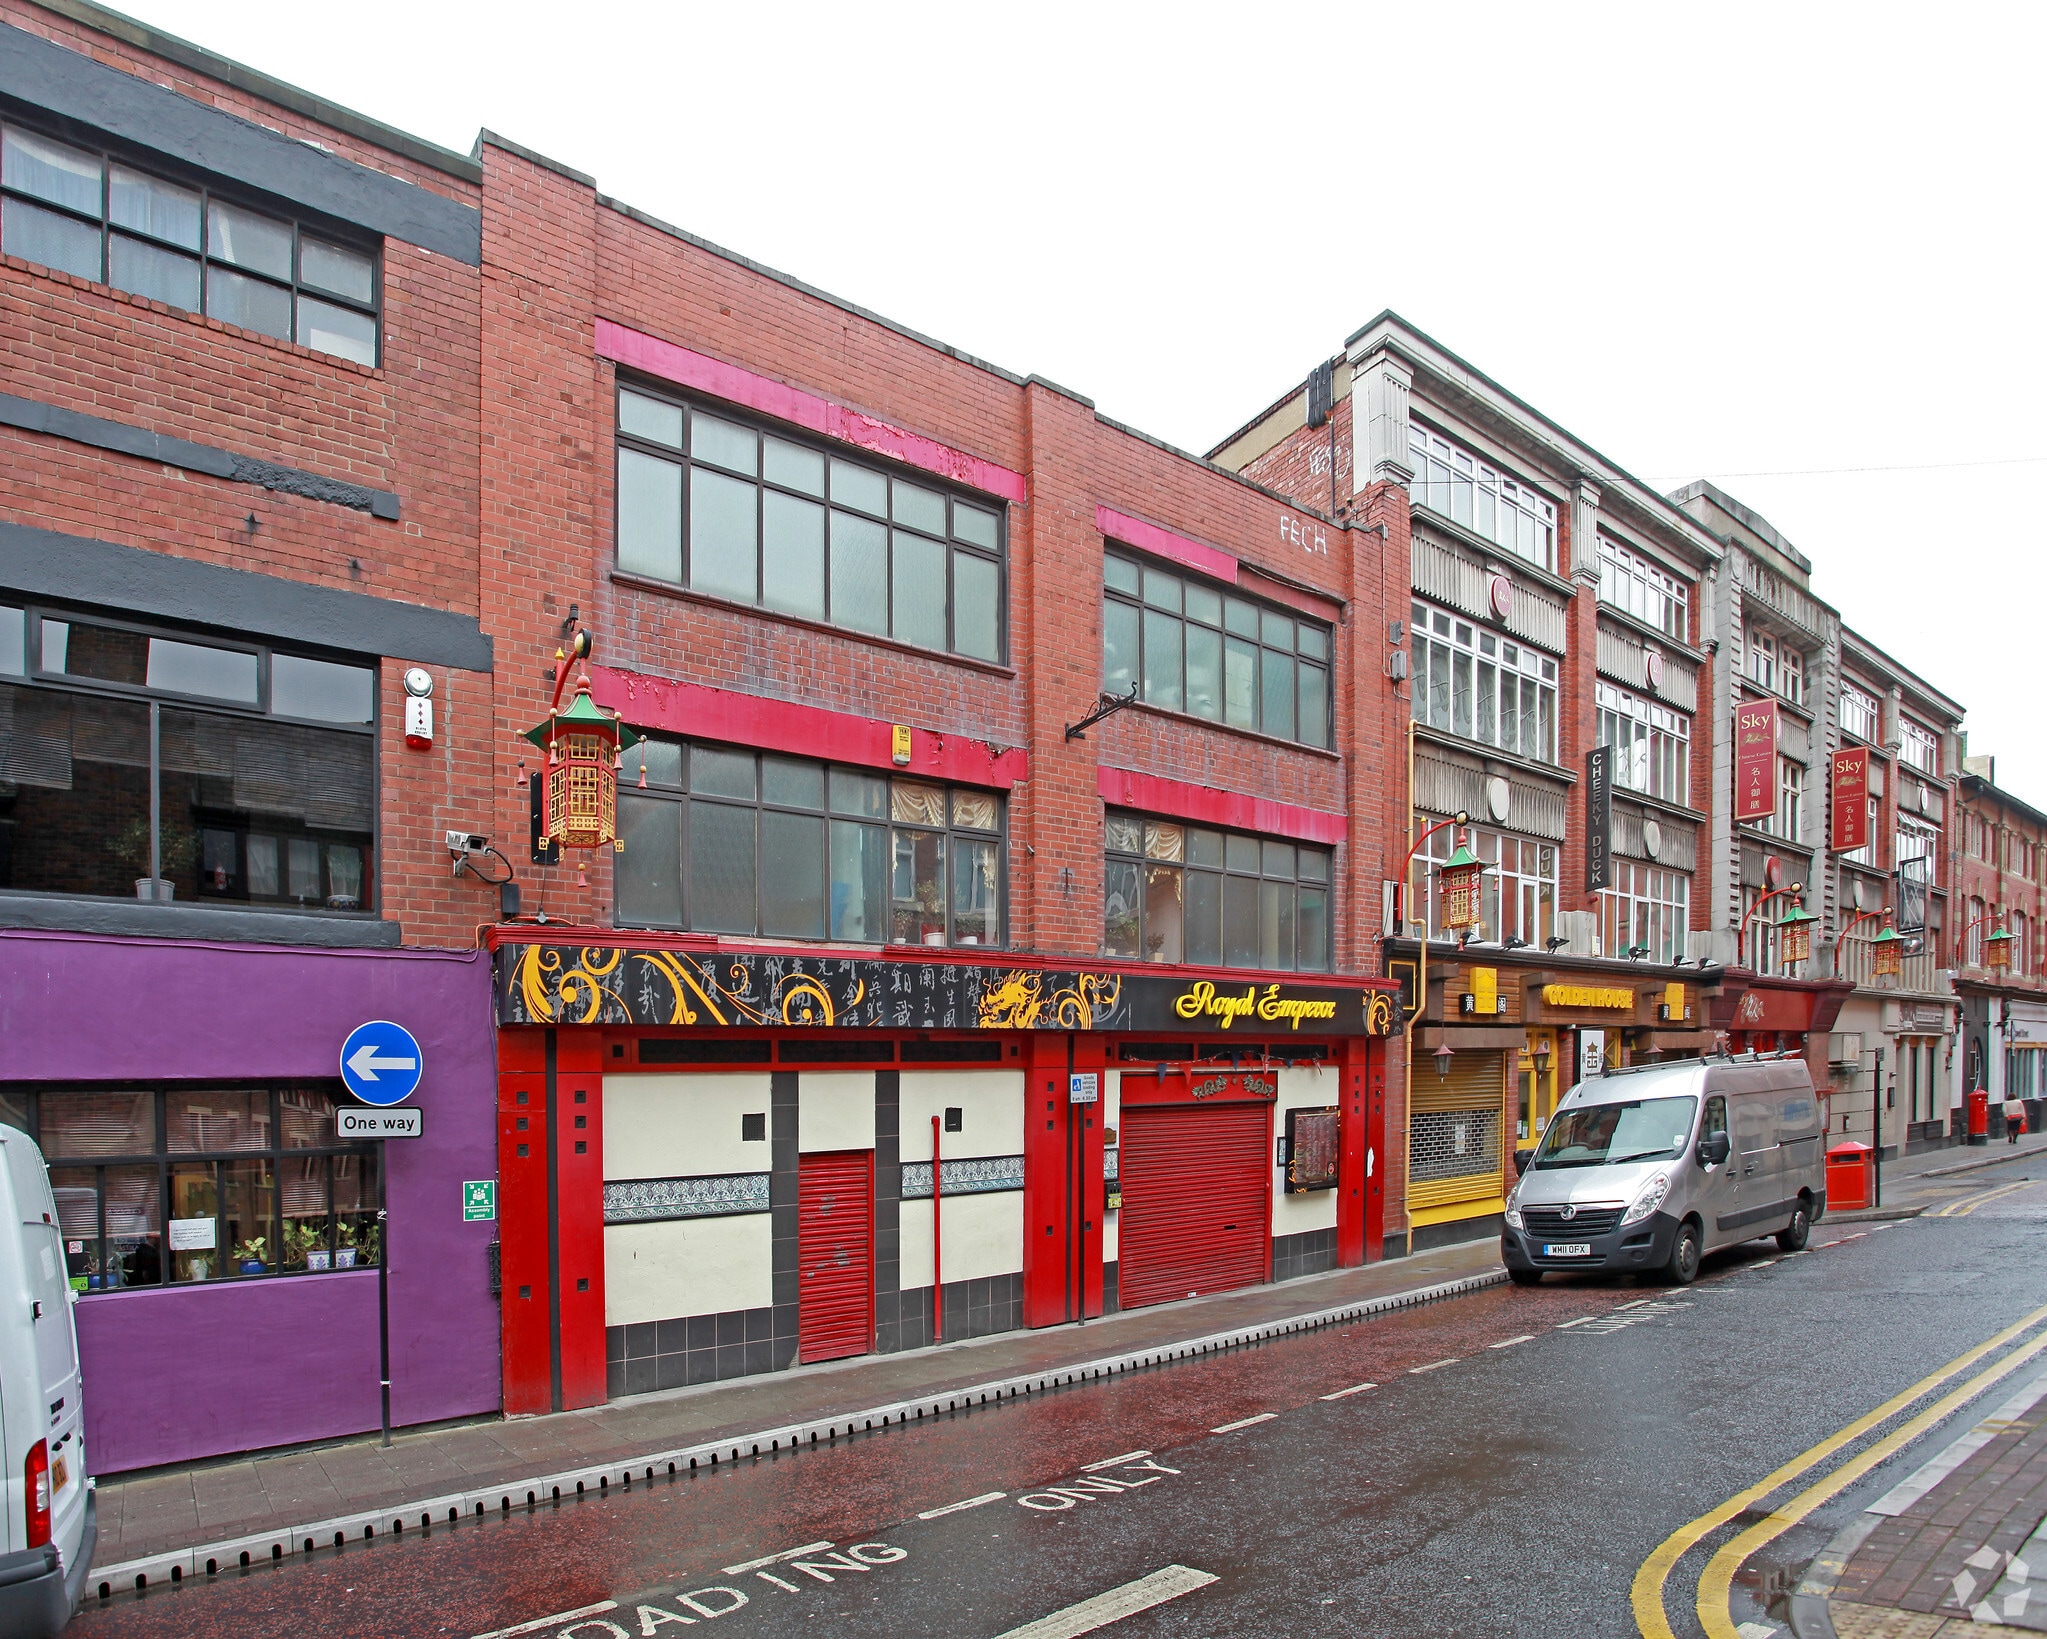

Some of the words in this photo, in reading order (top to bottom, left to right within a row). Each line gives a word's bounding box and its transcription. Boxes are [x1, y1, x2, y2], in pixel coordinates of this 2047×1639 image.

[1280, 515, 1327, 555] FECH
[1741, 713, 1770, 730] Sky
[1836, 759, 1862, 774] Sky
[1592, 753, 1602, 826] CHEEKY
[1591, 835, 1602, 884] DUCK
[1175, 981, 1255, 1030] Royal
[1257, 984, 1337, 1031] Emperor
[1543, 984, 1592, 1007] GOLDEN
[1592, 988, 1633, 1009] HOUSE
[344, 1115, 377, 1130] One
[383, 1119, 415, 1132] way
[1568, 1245, 1586, 1254] OFX
[1017, 1459, 1182, 1511] ONLY
